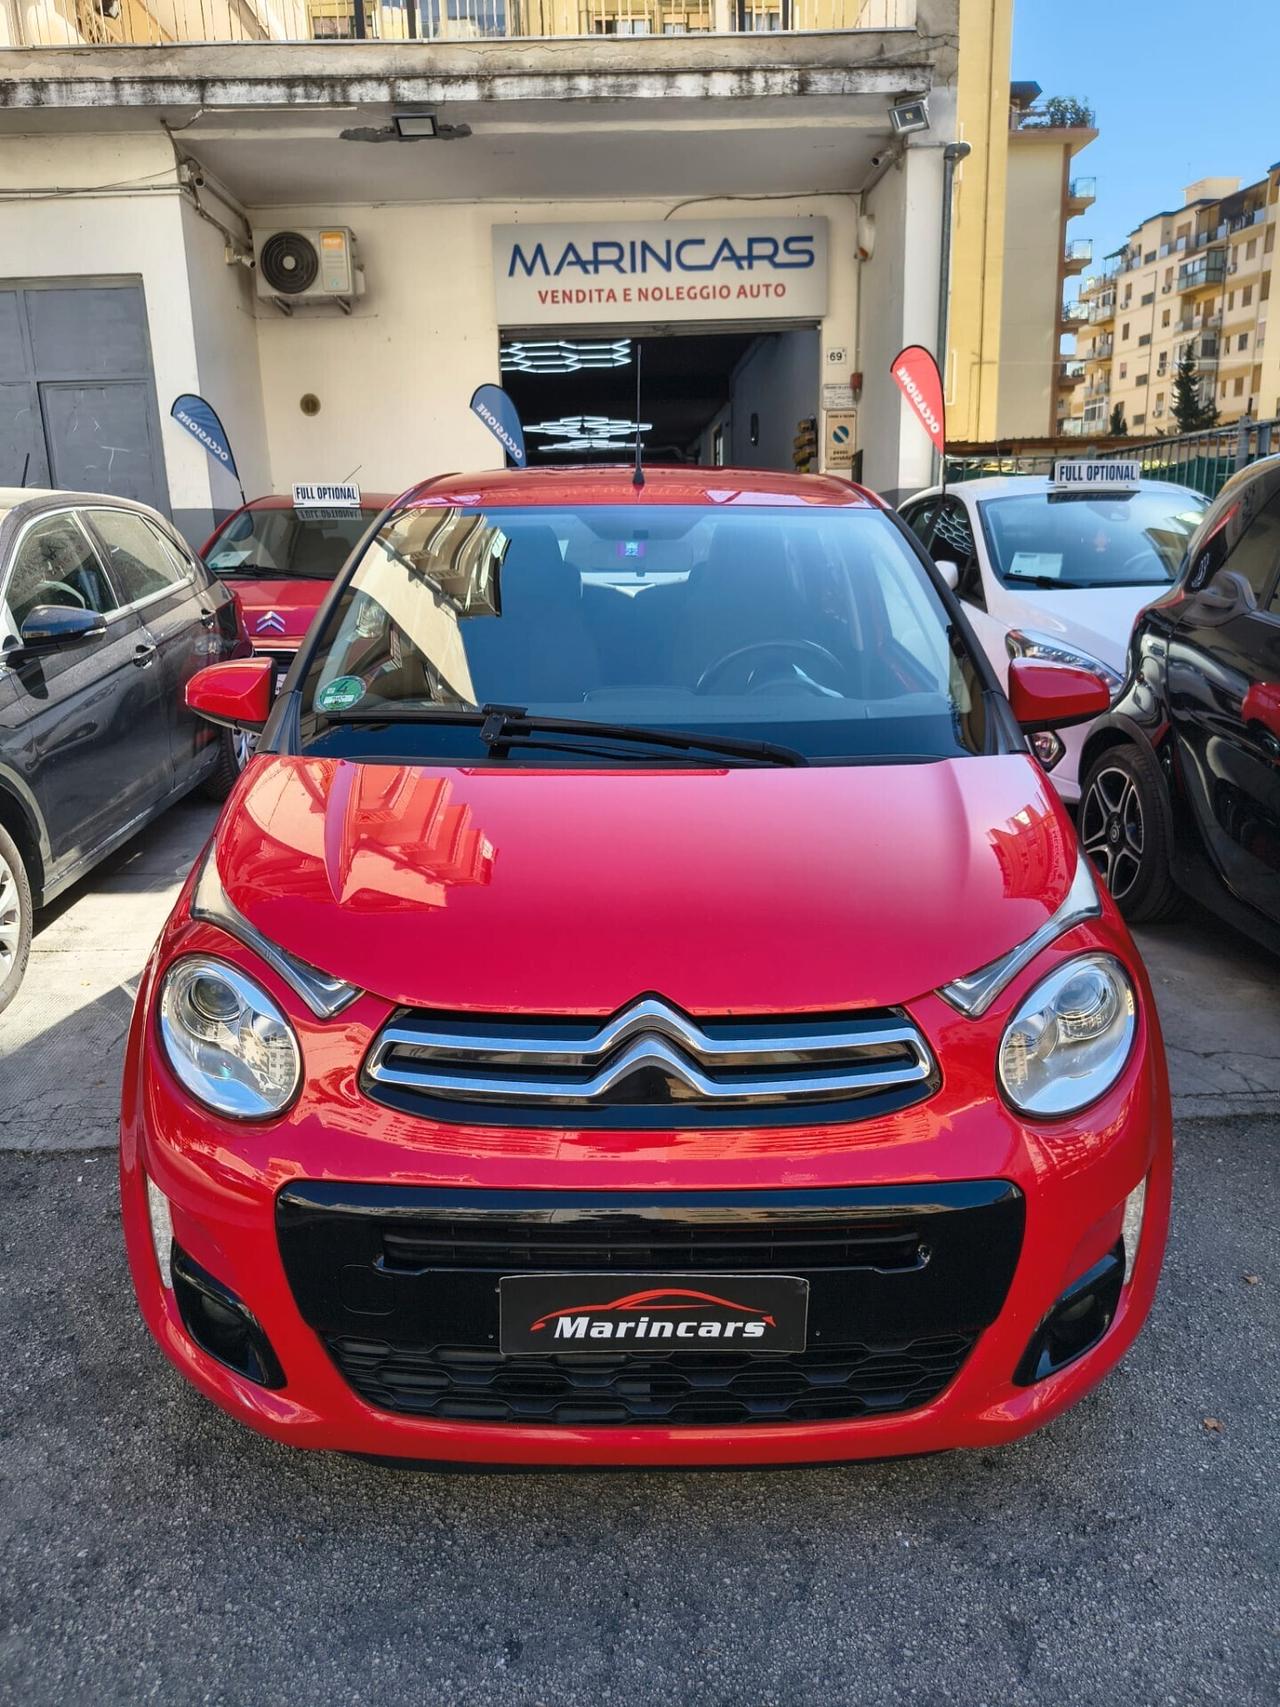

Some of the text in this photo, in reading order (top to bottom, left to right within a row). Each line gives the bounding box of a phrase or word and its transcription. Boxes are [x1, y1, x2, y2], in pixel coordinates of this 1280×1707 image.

[508, 236, 815, 277] MARINCARS
[538, 283, 786, 305] VENDITA E NOLEGGIO AUTO
[829, 351, 843, 361] 69
[1060, 465, 1136, 481] FULL OPTIONAL
[296, 487, 357, 500] FULL OPTIONAL
[554, 1316, 766, 1339] Marincars
